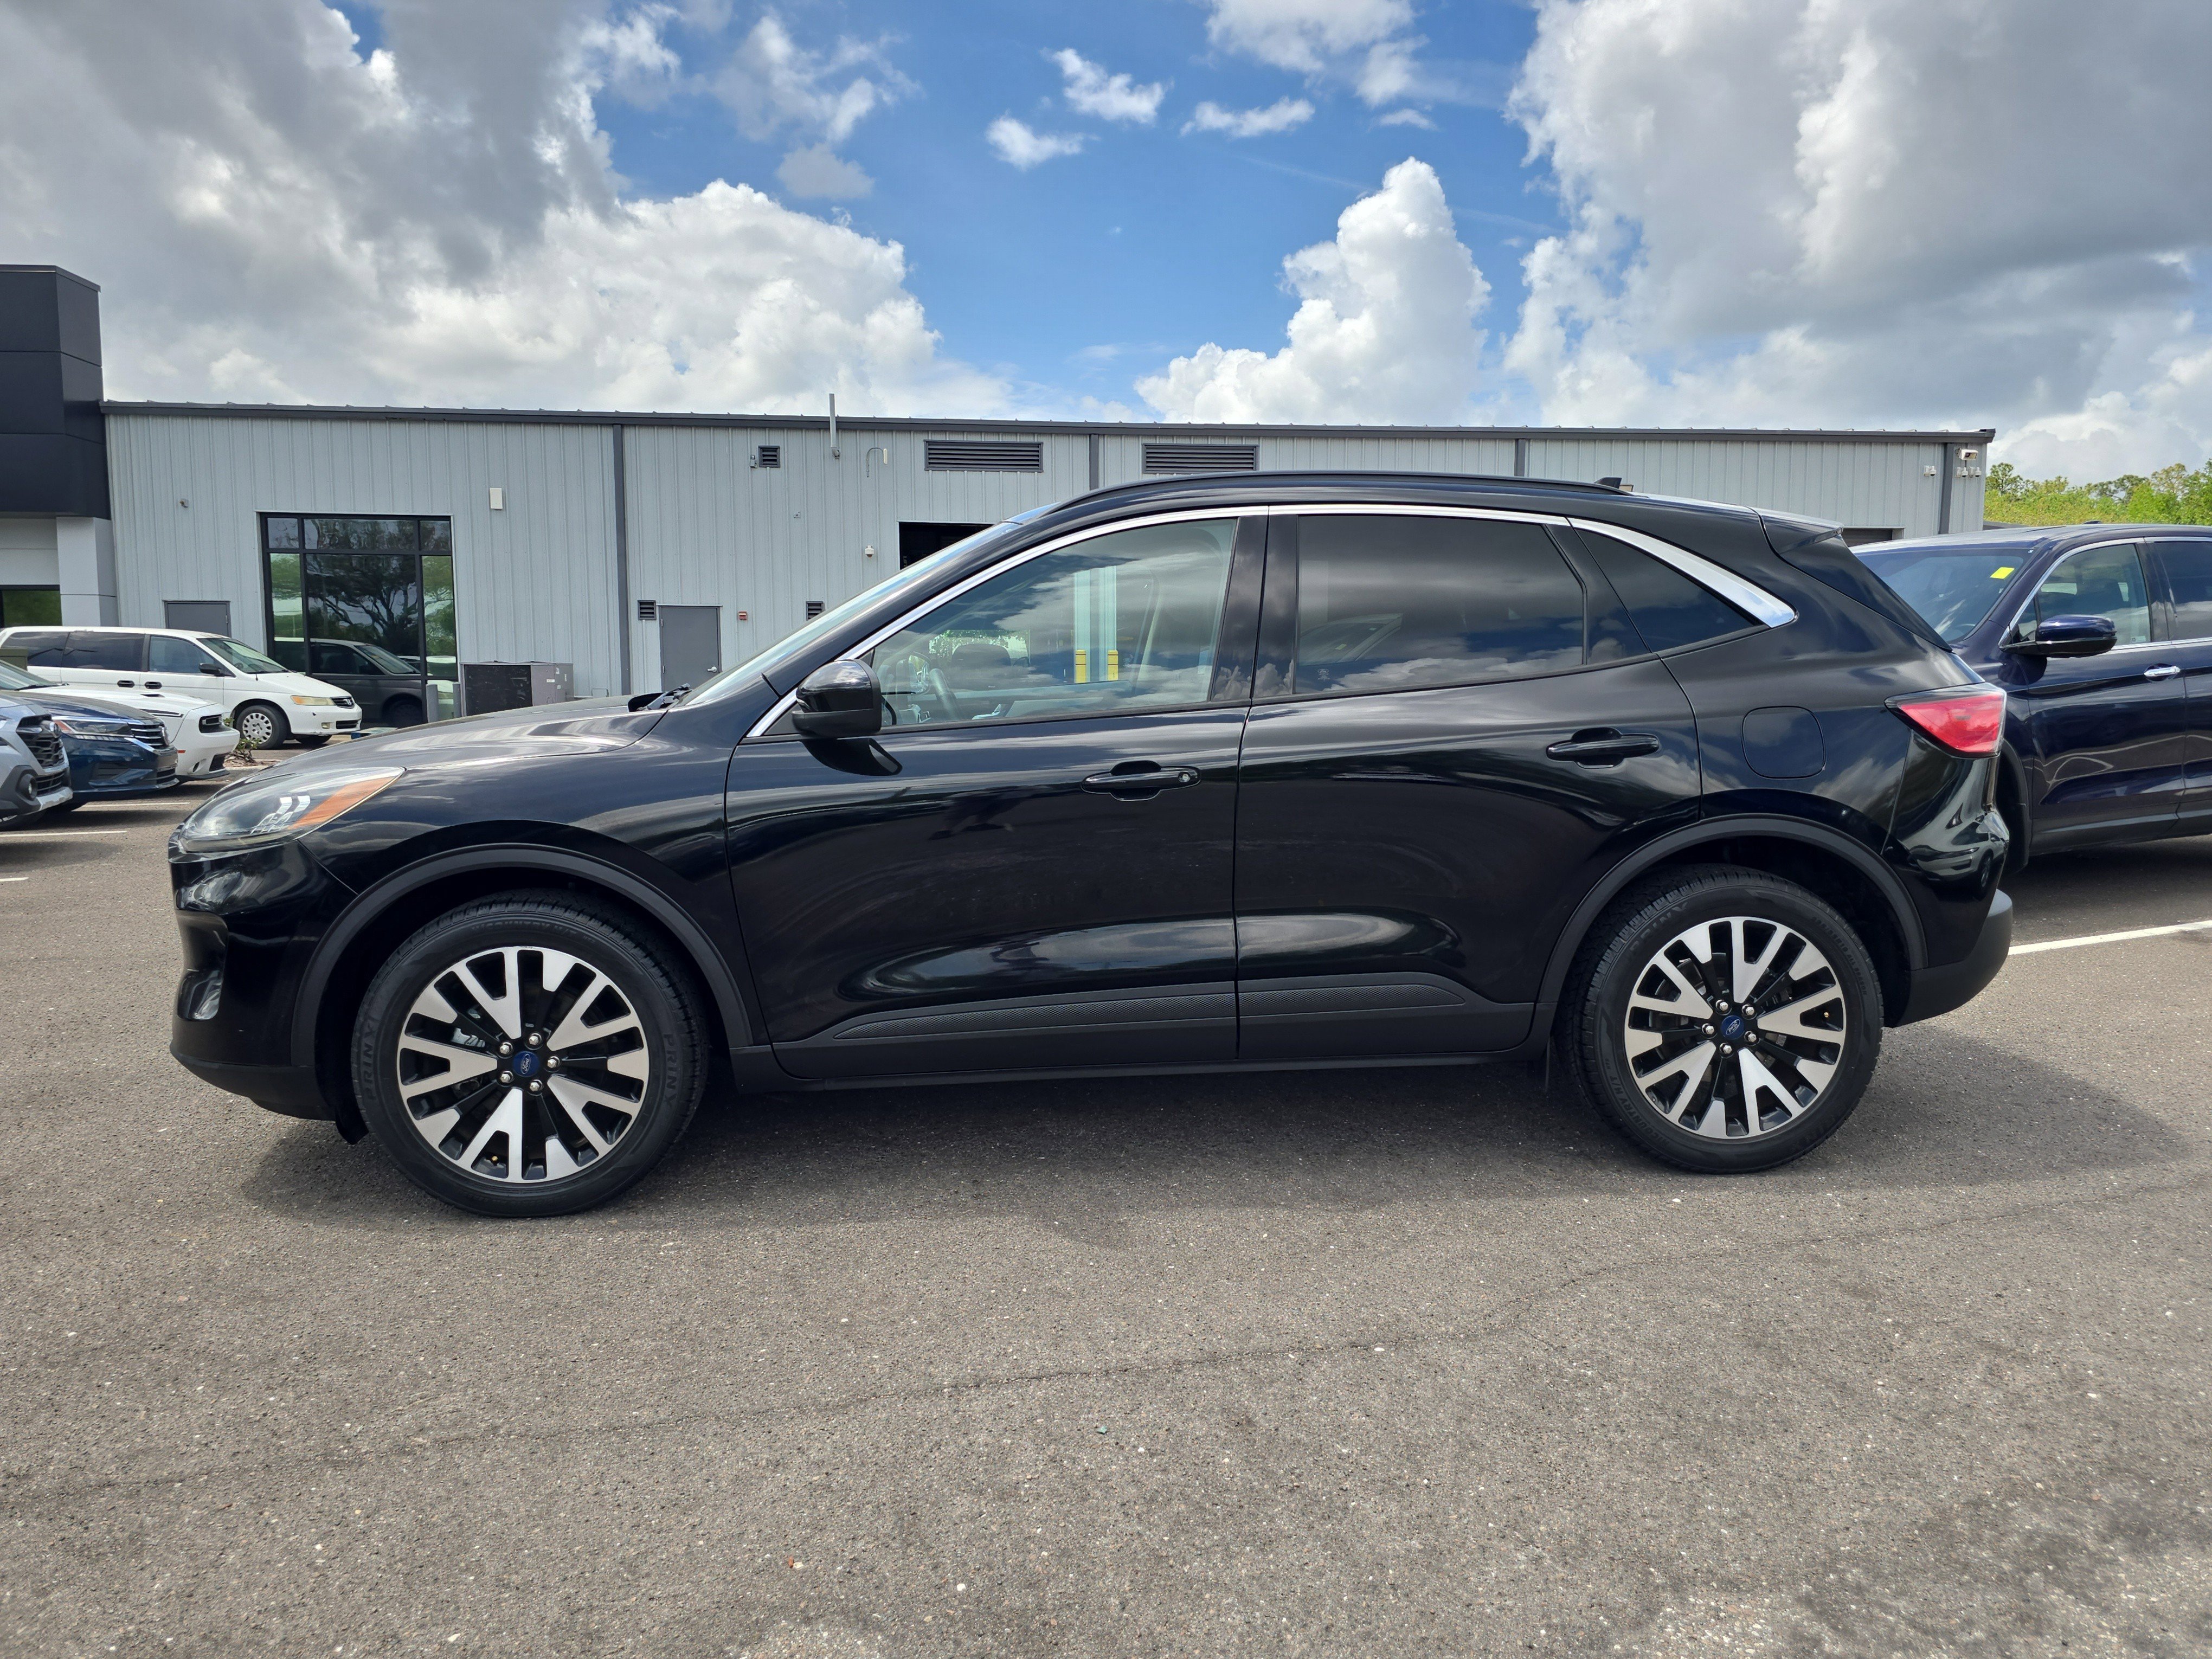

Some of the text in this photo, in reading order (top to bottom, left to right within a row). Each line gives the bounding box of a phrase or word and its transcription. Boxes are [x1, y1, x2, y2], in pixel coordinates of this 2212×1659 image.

[363, 1021, 377, 1101] PRINX
[522, 1057, 530, 1071] Ford
[663, 1033, 677, 1109] PRINX
